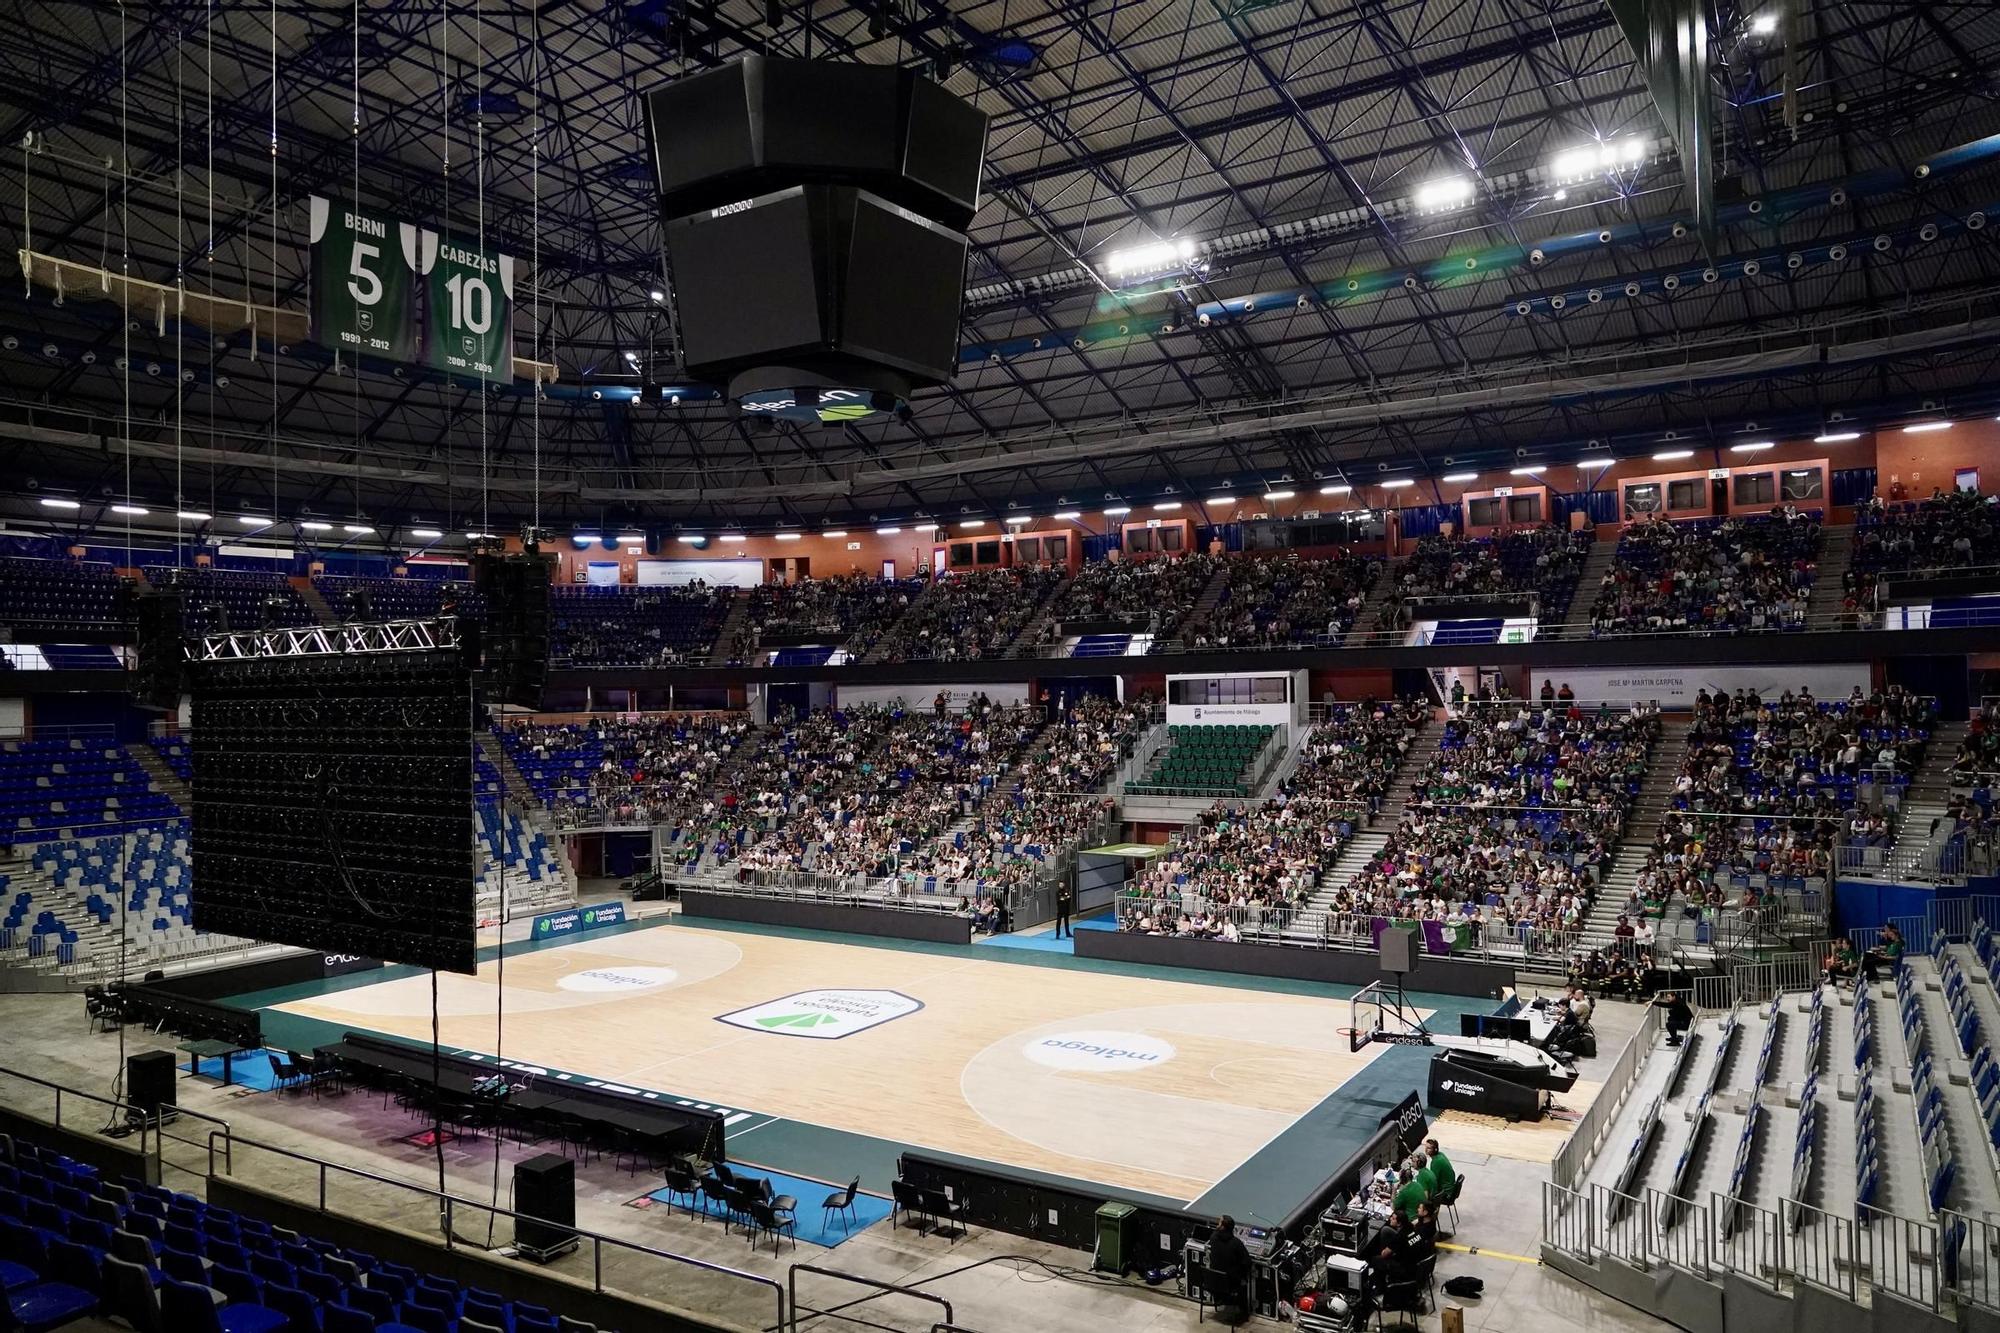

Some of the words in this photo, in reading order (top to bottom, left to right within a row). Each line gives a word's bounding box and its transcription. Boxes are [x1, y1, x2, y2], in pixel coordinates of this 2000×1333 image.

[719, 198, 753, 217] MONDO
[344, 212, 386, 239] BERNI
[440, 244, 497, 274] CABEZAS
[347, 241, 383, 306] 5
[444, 272, 492, 334] 10
[340, 331, 361, 344] 1999
[370, 338, 390, 350] 2012
[1655, 678, 1684, 686] CARPENA
[595, 906, 623, 917] Fundación
[551, 914, 578, 925] Fundación
[597, 914, 617, 923] Unicaja
[552, 921, 573, 931] Unicaja
[1385, 1035, 1424, 1047] endesa
[1041, 1039, 1158, 1061] málaga
[1454, 1081, 1484, 1093] Fundación
[1454, 1086, 1476, 1096] Unicaja
